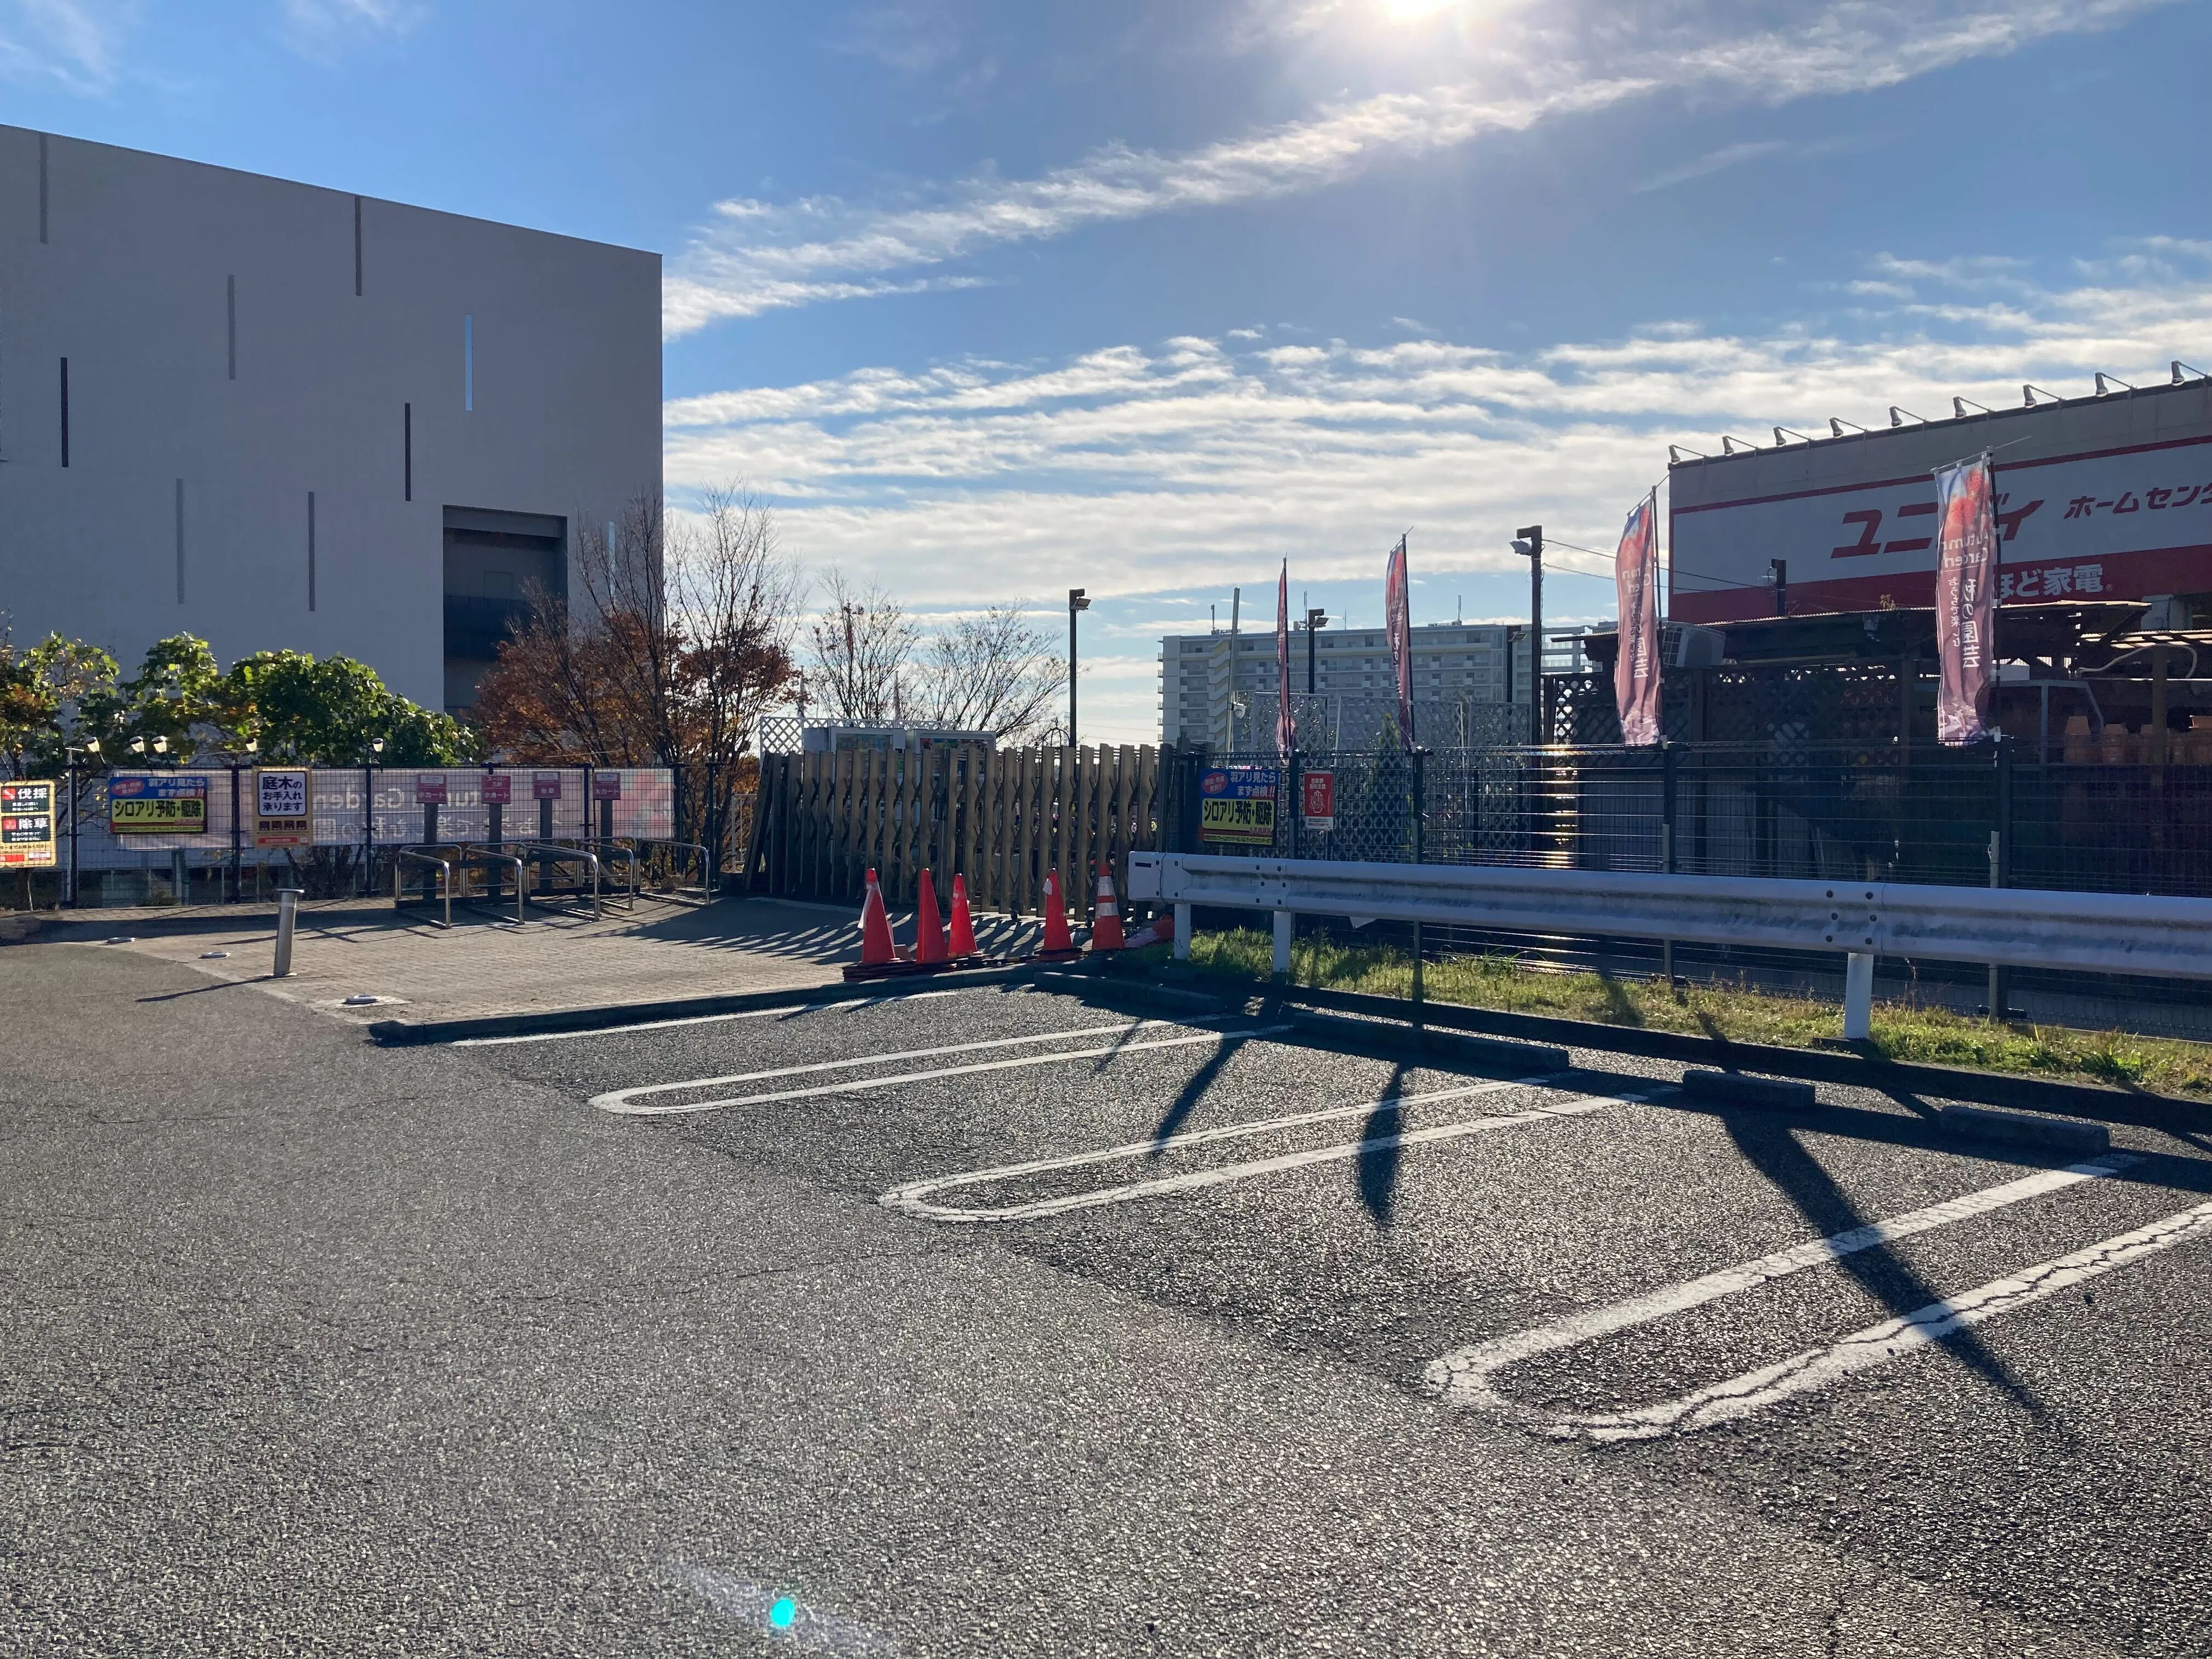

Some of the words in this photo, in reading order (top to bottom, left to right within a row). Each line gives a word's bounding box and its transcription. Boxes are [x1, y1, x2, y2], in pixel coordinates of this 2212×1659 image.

[262, 776, 302, 790] 庭木の
[1230, 771, 1276, 783] 羽アリ見たら
[18, 787, 47, 799] 伐採
[262, 791, 302, 801] お手入れ
[263, 802, 303, 811] 承ります
[19, 817, 48, 830] 除草
